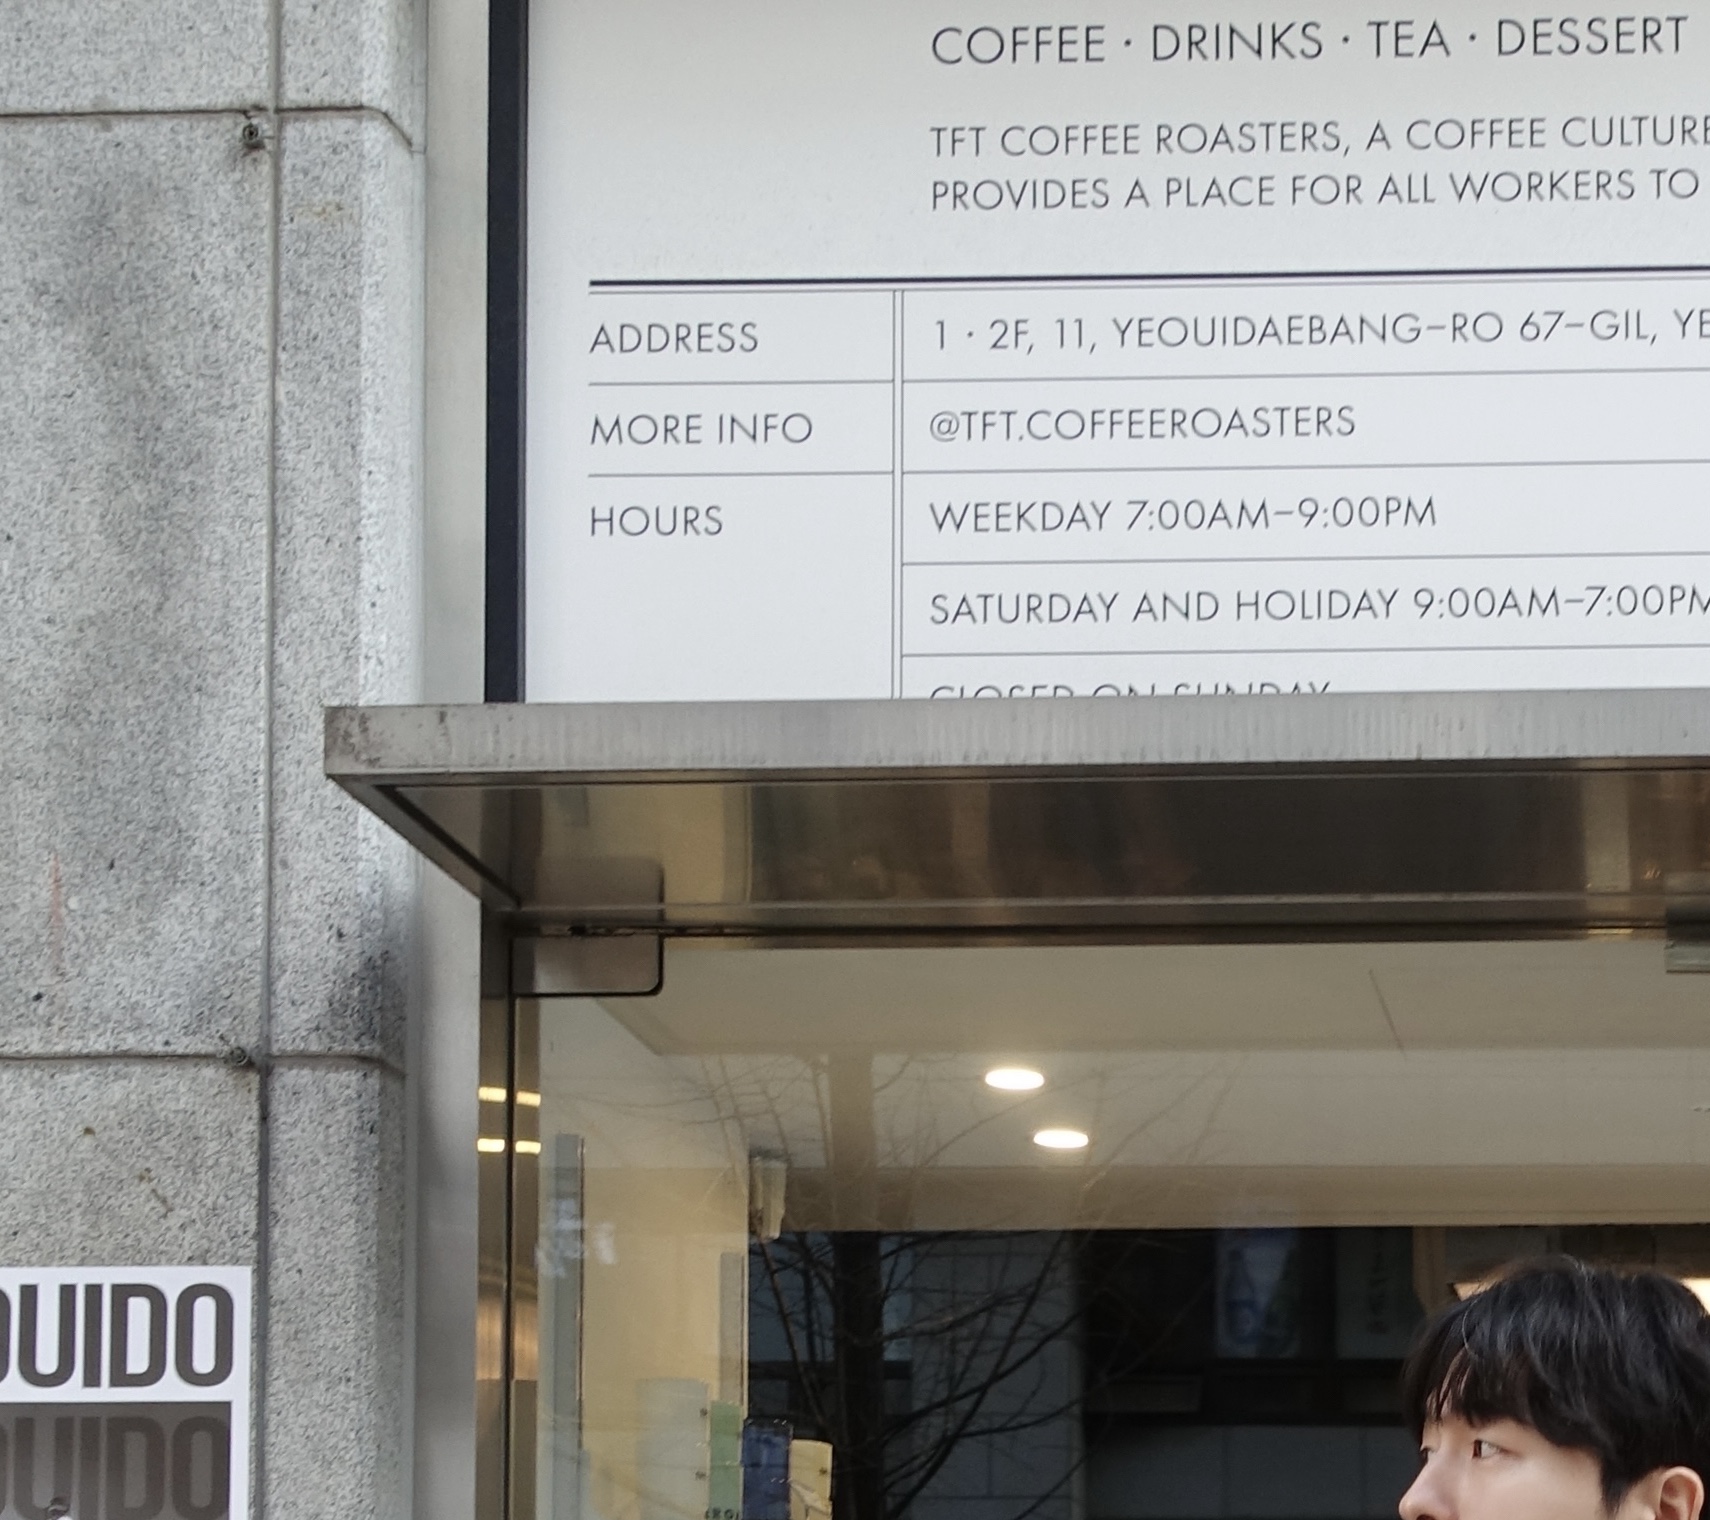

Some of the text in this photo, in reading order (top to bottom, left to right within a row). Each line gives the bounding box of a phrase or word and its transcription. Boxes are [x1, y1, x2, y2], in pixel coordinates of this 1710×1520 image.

[931, 24, 1106, 66] COFFEE
[1152, 20, 1324, 63] DRINKS
[1366, 17, 1452, 60] TEA
[1497, 14, 1690, 57] DESSERT
[928, 125, 988, 158] TFT
[1000, 123, 1141, 157] COFFEE
[1156, 119, 1351, 158] ROASTERS,
[1365, 119, 1393, 152] A
[1405, 116, 1547, 151] COFFEE
[932, 177, 1110, 212] PROVIDES
[1123, 176, 1151, 209] A
[1165, 174, 1276, 209] PLACE
[1291, 173, 1364, 207] FOR
[1376, 171, 1437, 205] ALL
[1448, 168, 1636, 204] WORKERS
[1648, 167, 1700, 200] TO
[588, 321, 759, 355] ADDRESS
[935, 319, 945, 351] 1
[989, 318, 1035, 356] 2F,
[1054, 317, 1097, 356] 11,
[1111, 310, 1504, 349] YEOUIDAEBANG-RO
[1519, 308, 1658, 347] 67-GIL,
[589, 412, 813, 446] MORE INFO
[929, 404, 1356, 443] @TFT.COFFEEROASTERS
[590, 504, 723, 538] HOURS
[928, 495, 1437, 535] WEEKDAY 7:00AM-9:00PM
[929, 591, 1120, 626] SATURDAY
[1131, 590, 1220, 623] AND
[1235, 587, 1400, 622] HOLIDAY
[0, 1283, 235, 1389] UIDO
